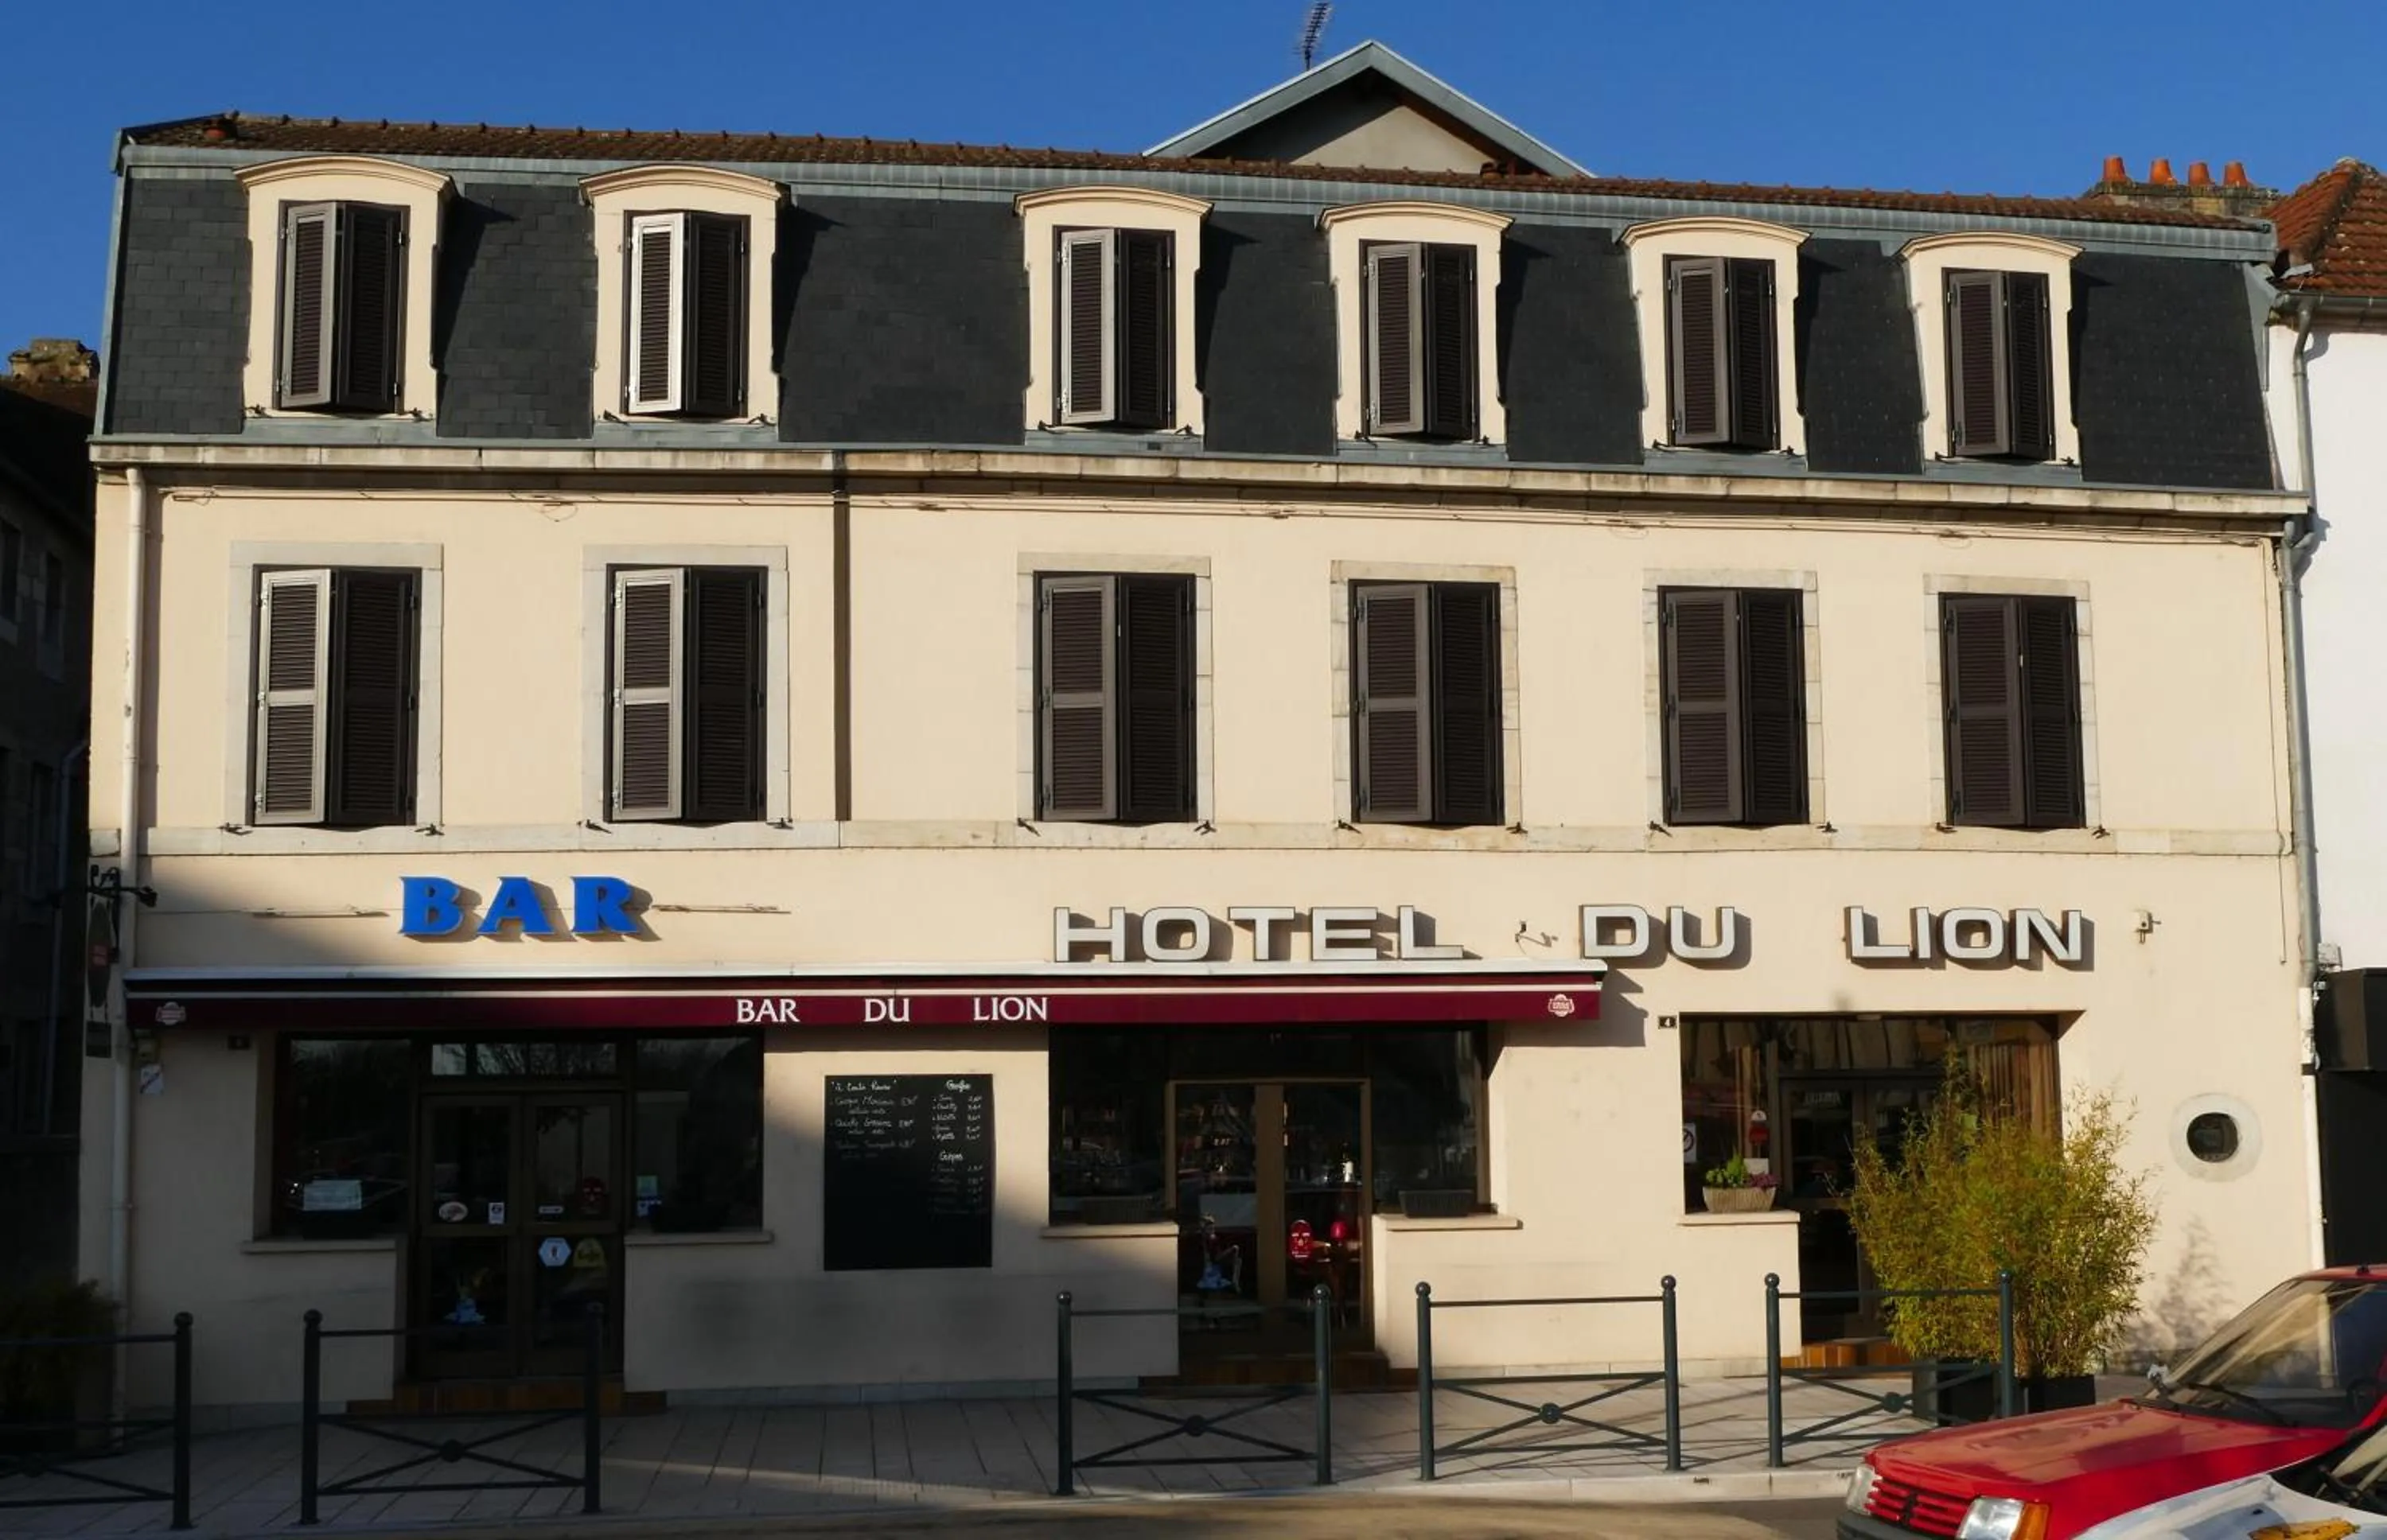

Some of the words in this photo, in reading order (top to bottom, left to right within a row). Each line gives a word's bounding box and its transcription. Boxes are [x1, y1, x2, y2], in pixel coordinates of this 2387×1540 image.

[399, 875, 641, 935] BAR
[1053, 904, 1464, 962] HOTEL
[1579, 904, 1735, 958] DU
[1847, 905, 2081, 961] LION
[736, 998, 800, 1023] BAR
[864, 998, 910, 1023] DU
[973, 997, 1049, 1021] LION
